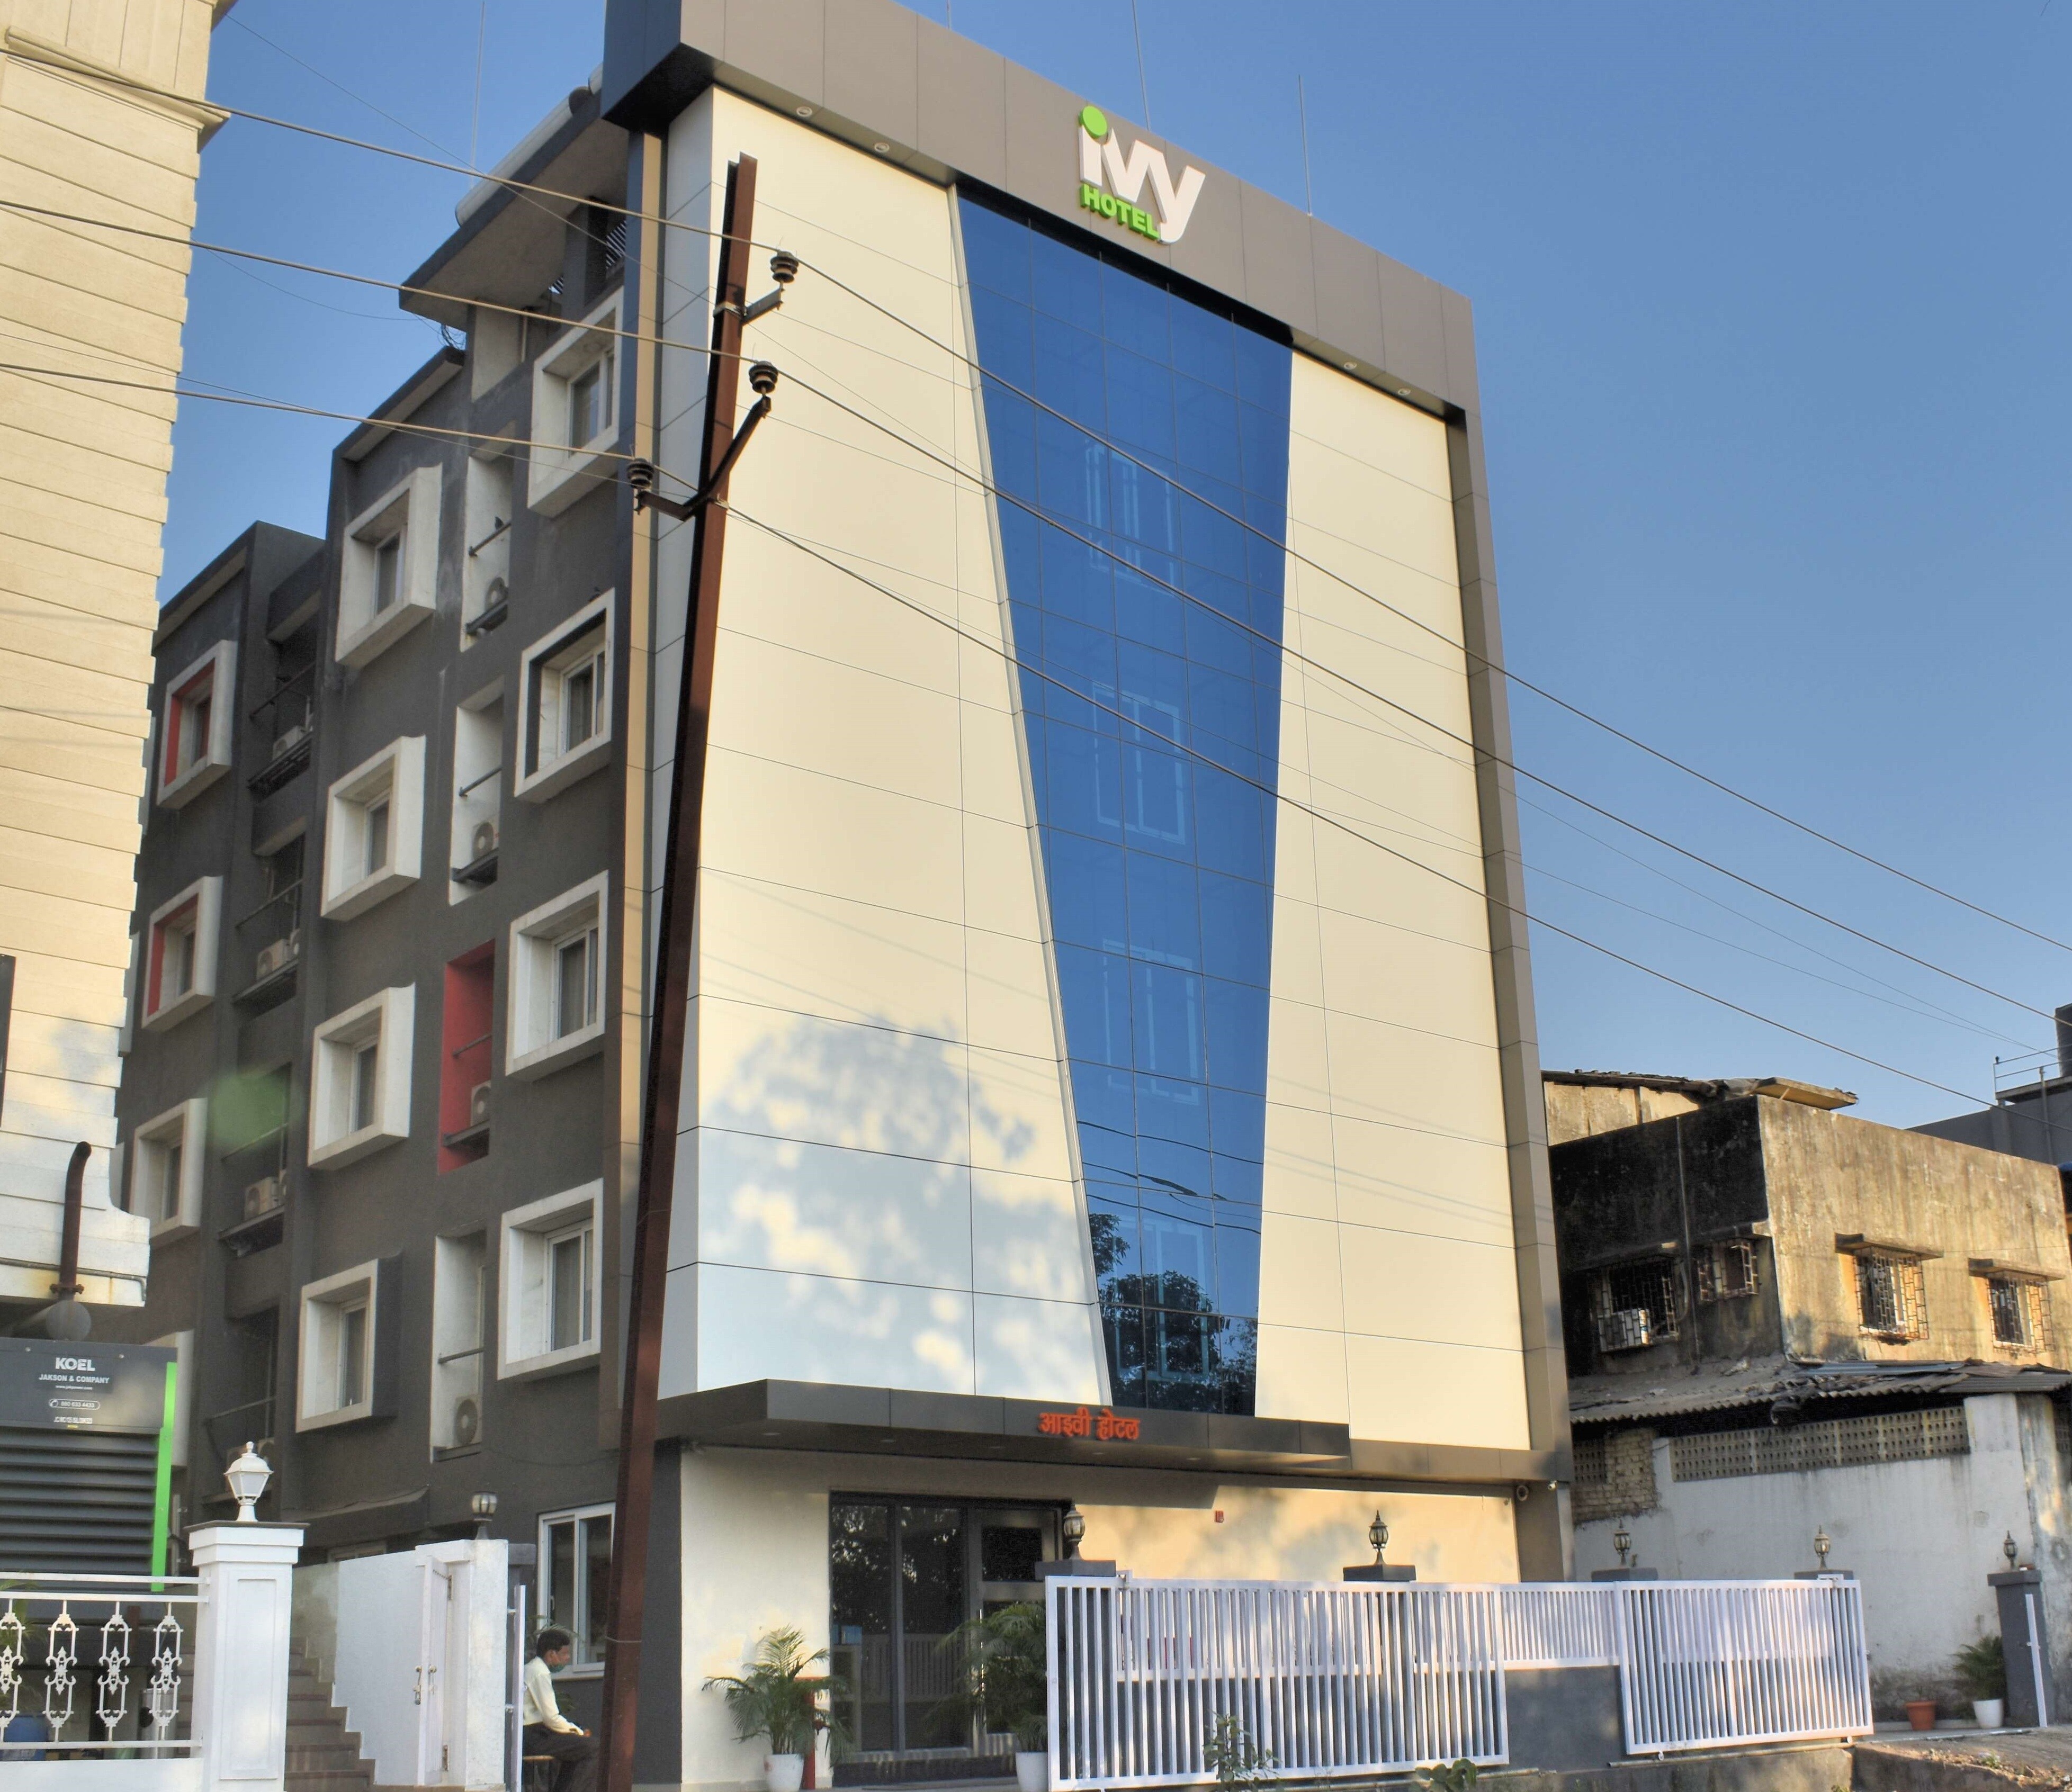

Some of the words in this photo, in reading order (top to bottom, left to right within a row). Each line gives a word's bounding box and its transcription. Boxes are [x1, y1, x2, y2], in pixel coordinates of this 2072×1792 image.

[1078, 105, 1206, 244] ivy
[1079, 183, 1161, 241] HOTEL
[55, 1357, 96, 1372] KOEL
[1038, 1406, 1092, 1437] आइवी
[1096, 1408, 1140, 1440] होटल
